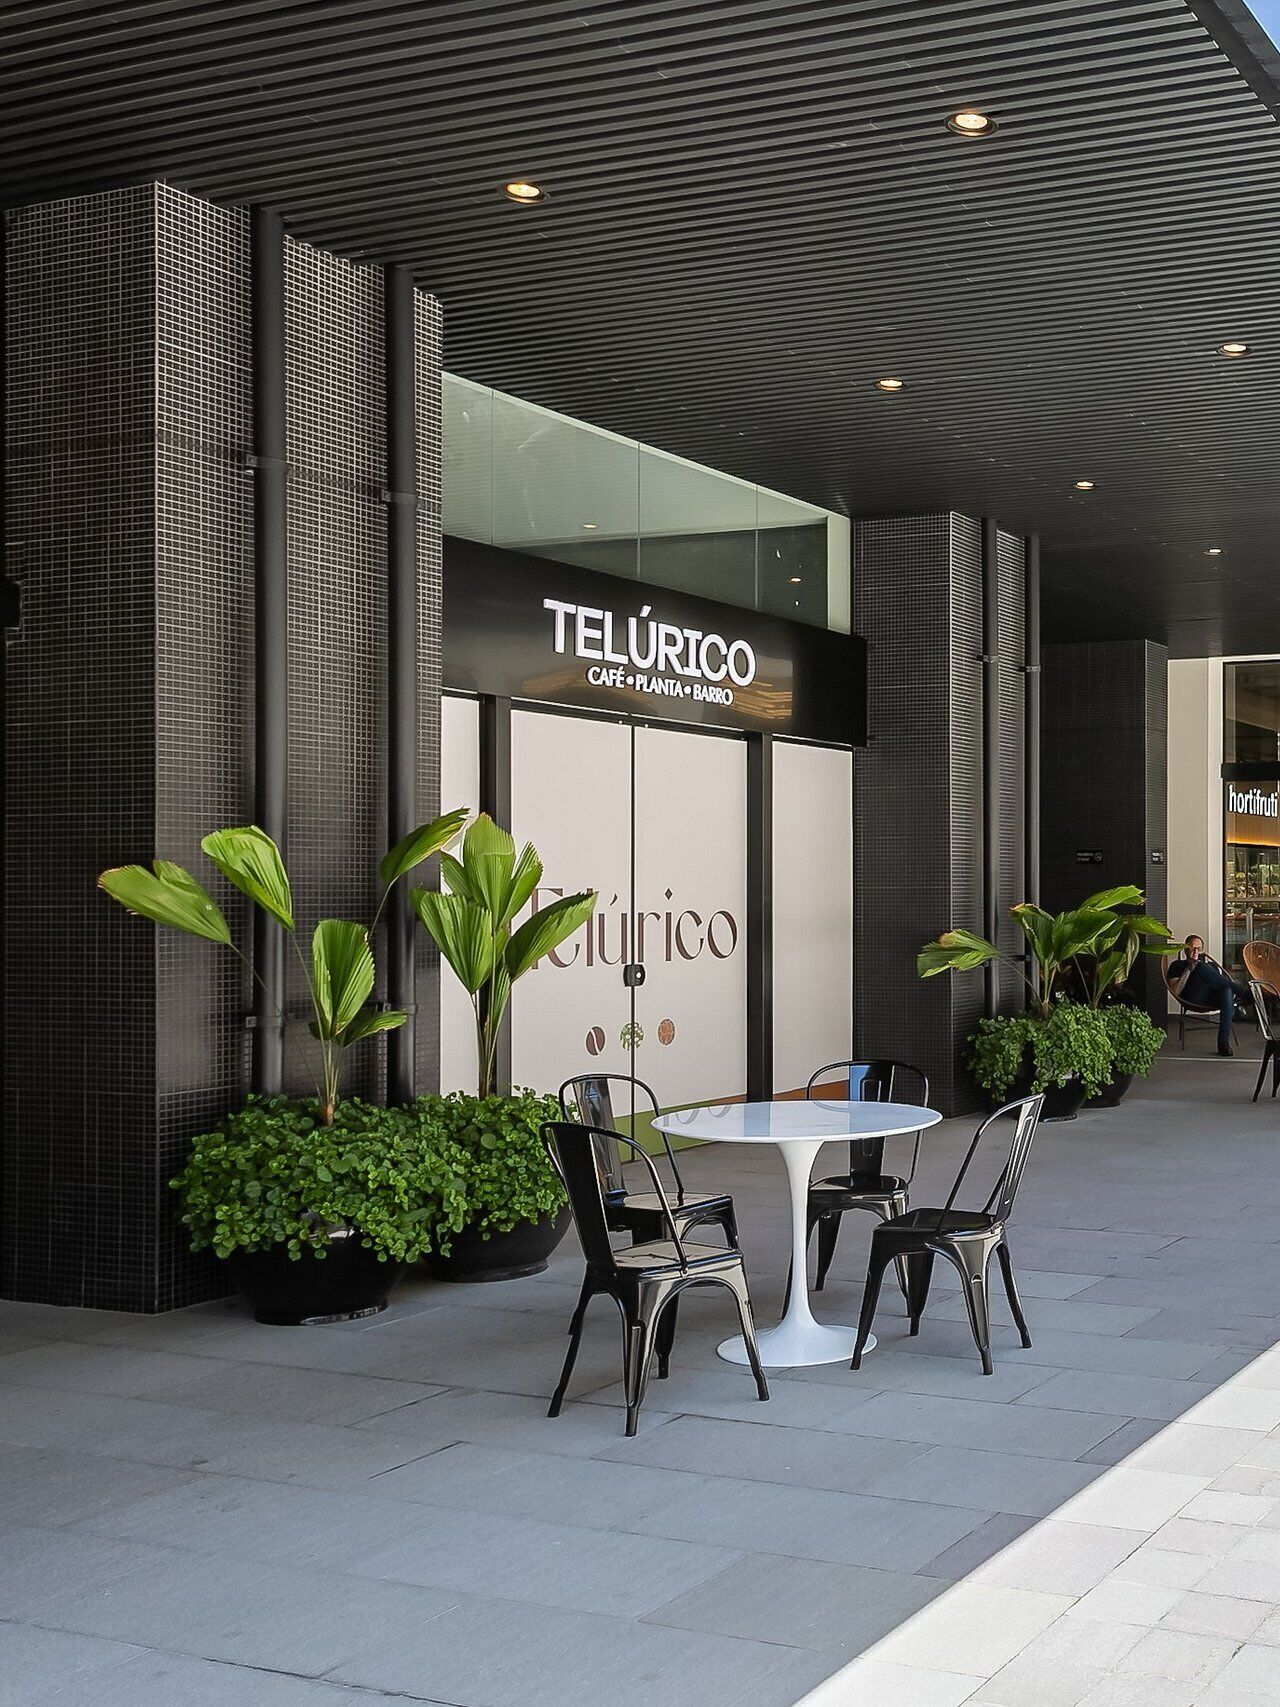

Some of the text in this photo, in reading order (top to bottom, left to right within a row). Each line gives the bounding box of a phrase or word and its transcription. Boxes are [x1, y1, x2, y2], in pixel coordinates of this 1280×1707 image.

[543, 598, 757, 687] TELÚRICO
[586, 666, 734, 706] CAFÉ PLANTA BARRO
[1229, 784, 1278, 818] hortifruti
